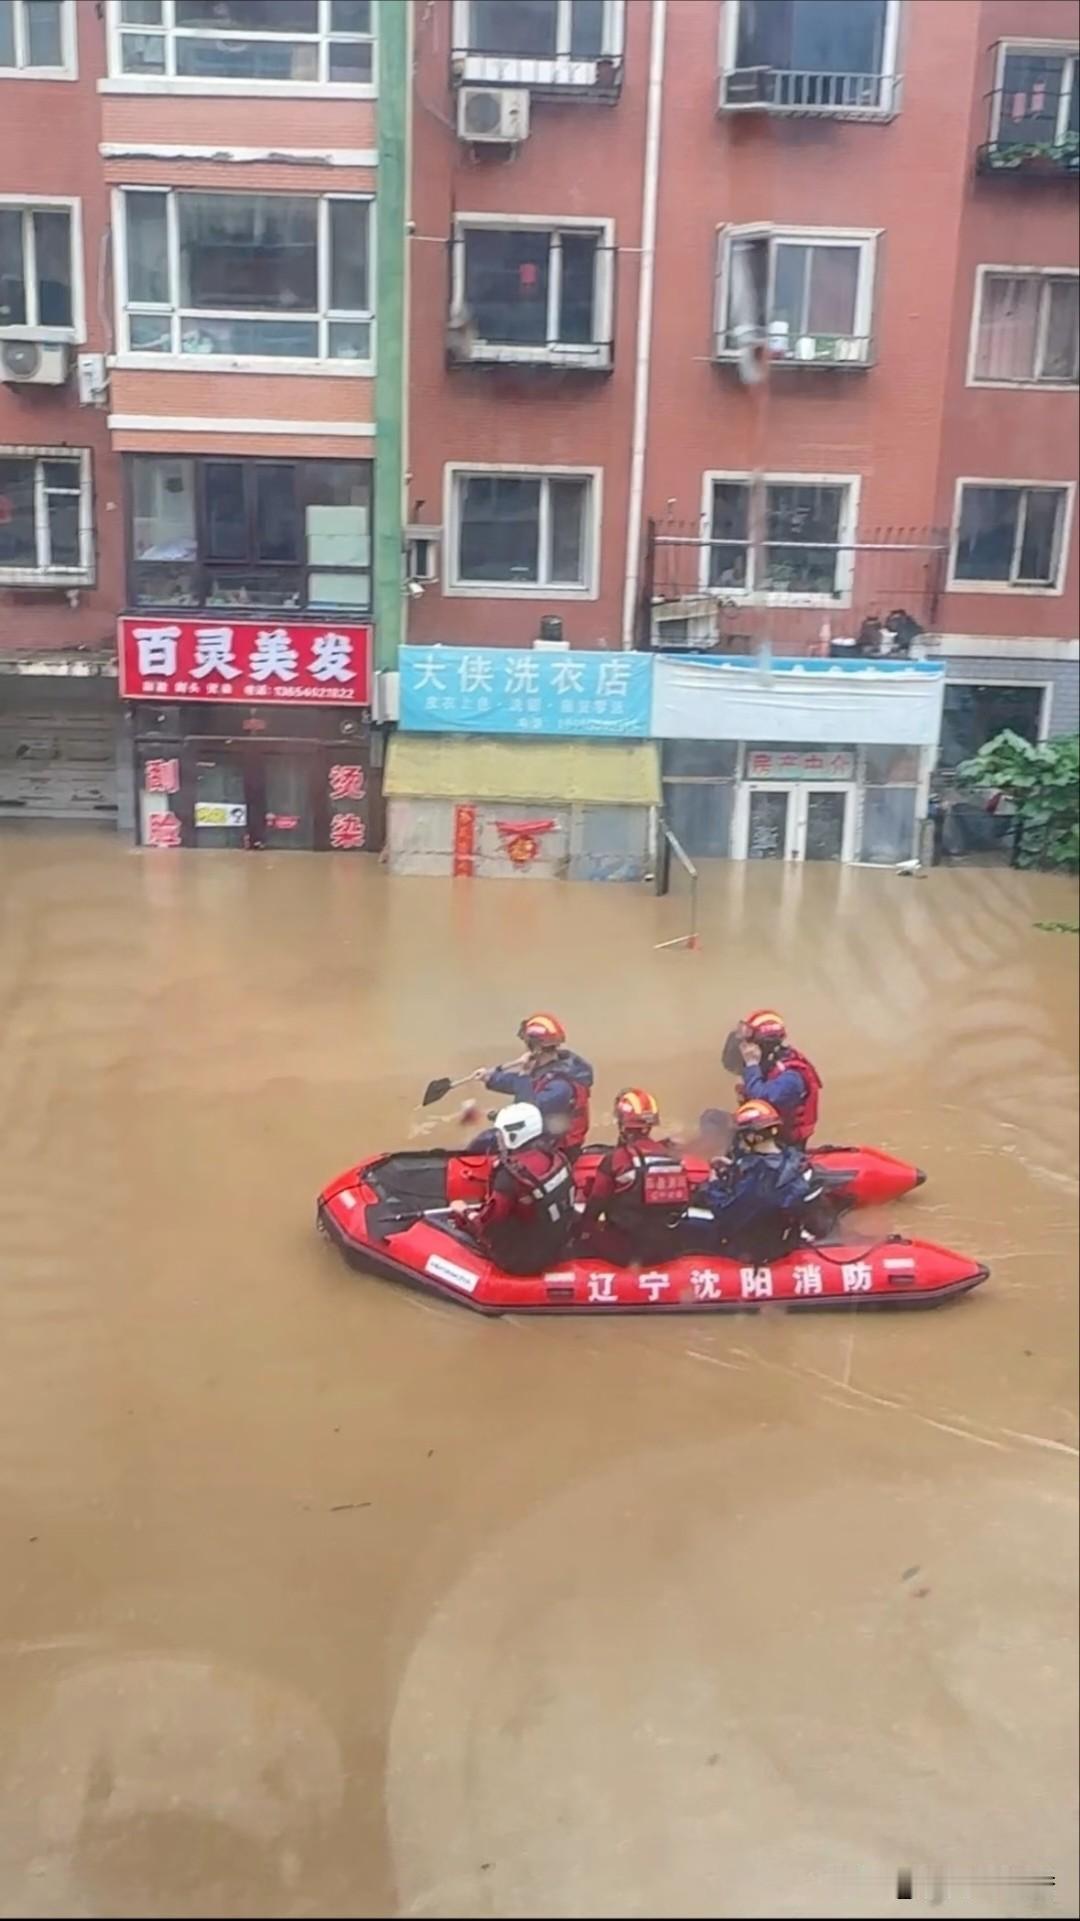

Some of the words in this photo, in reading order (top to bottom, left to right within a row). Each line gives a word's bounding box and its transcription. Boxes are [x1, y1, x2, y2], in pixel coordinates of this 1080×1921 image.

[132, 626, 356, 682] 百灵美发
[413, 654, 632, 696] 大侠洗衣店
[752, 753, 849, 776] 房产中介
[329, 765, 366, 848] 烫染
[587, 1263, 872, 1301] 辽宁沈阳消防
